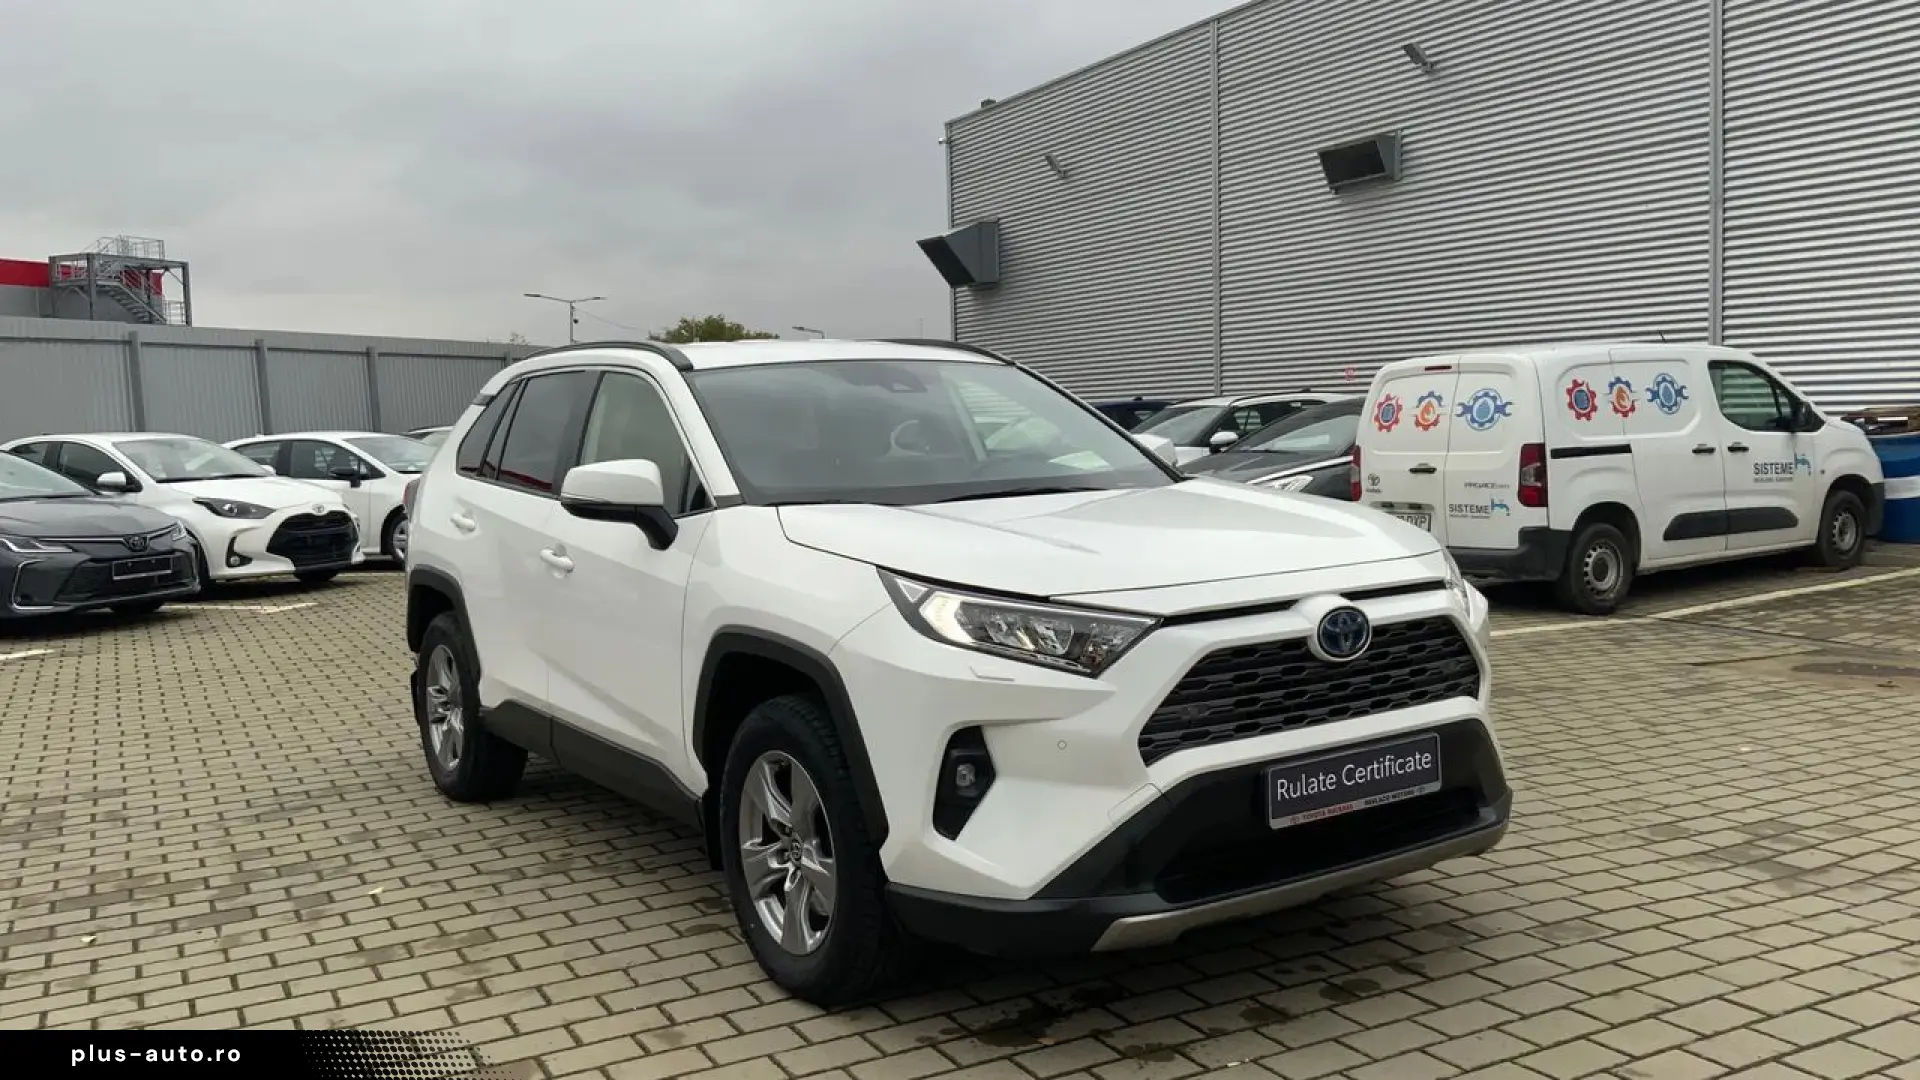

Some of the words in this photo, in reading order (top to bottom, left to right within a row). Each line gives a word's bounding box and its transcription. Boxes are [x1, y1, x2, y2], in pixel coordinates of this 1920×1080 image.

[1753, 462, 1794, 475] SISTEME
[1448, 503, 1490, 515] SISTEME
[1277, 772, 1337, 801] Rulate
[1342, 751, 1432, 786] Certificate
